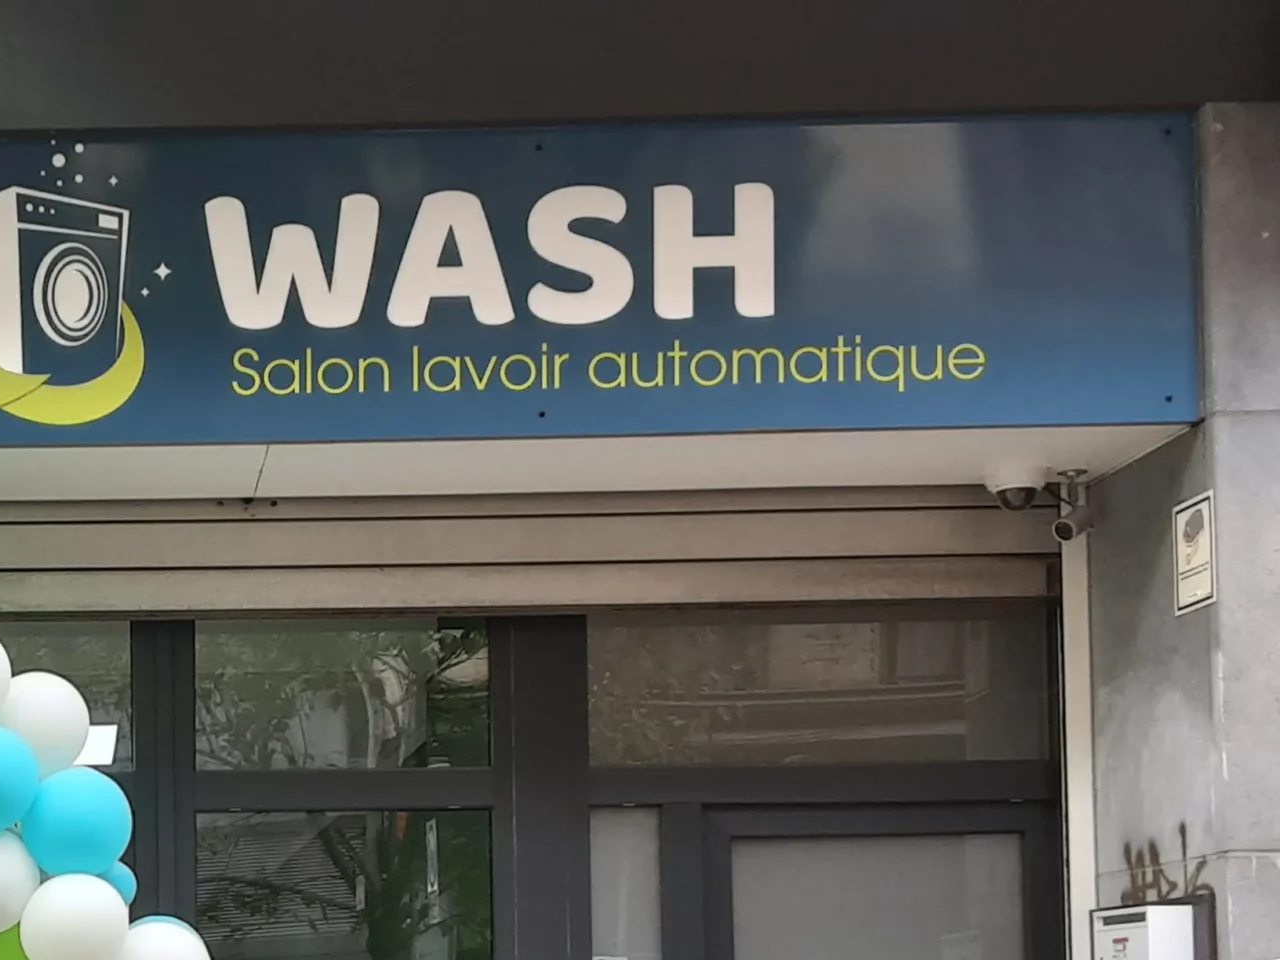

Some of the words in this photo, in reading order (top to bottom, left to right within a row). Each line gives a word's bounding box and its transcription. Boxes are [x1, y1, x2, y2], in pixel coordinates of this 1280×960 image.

[204, 182, 775, 330] WASH
[231, 347, 390, 397] Salon
[412, 341, 570, 393] lavoir
[589, 335, 986, 392] automatique
